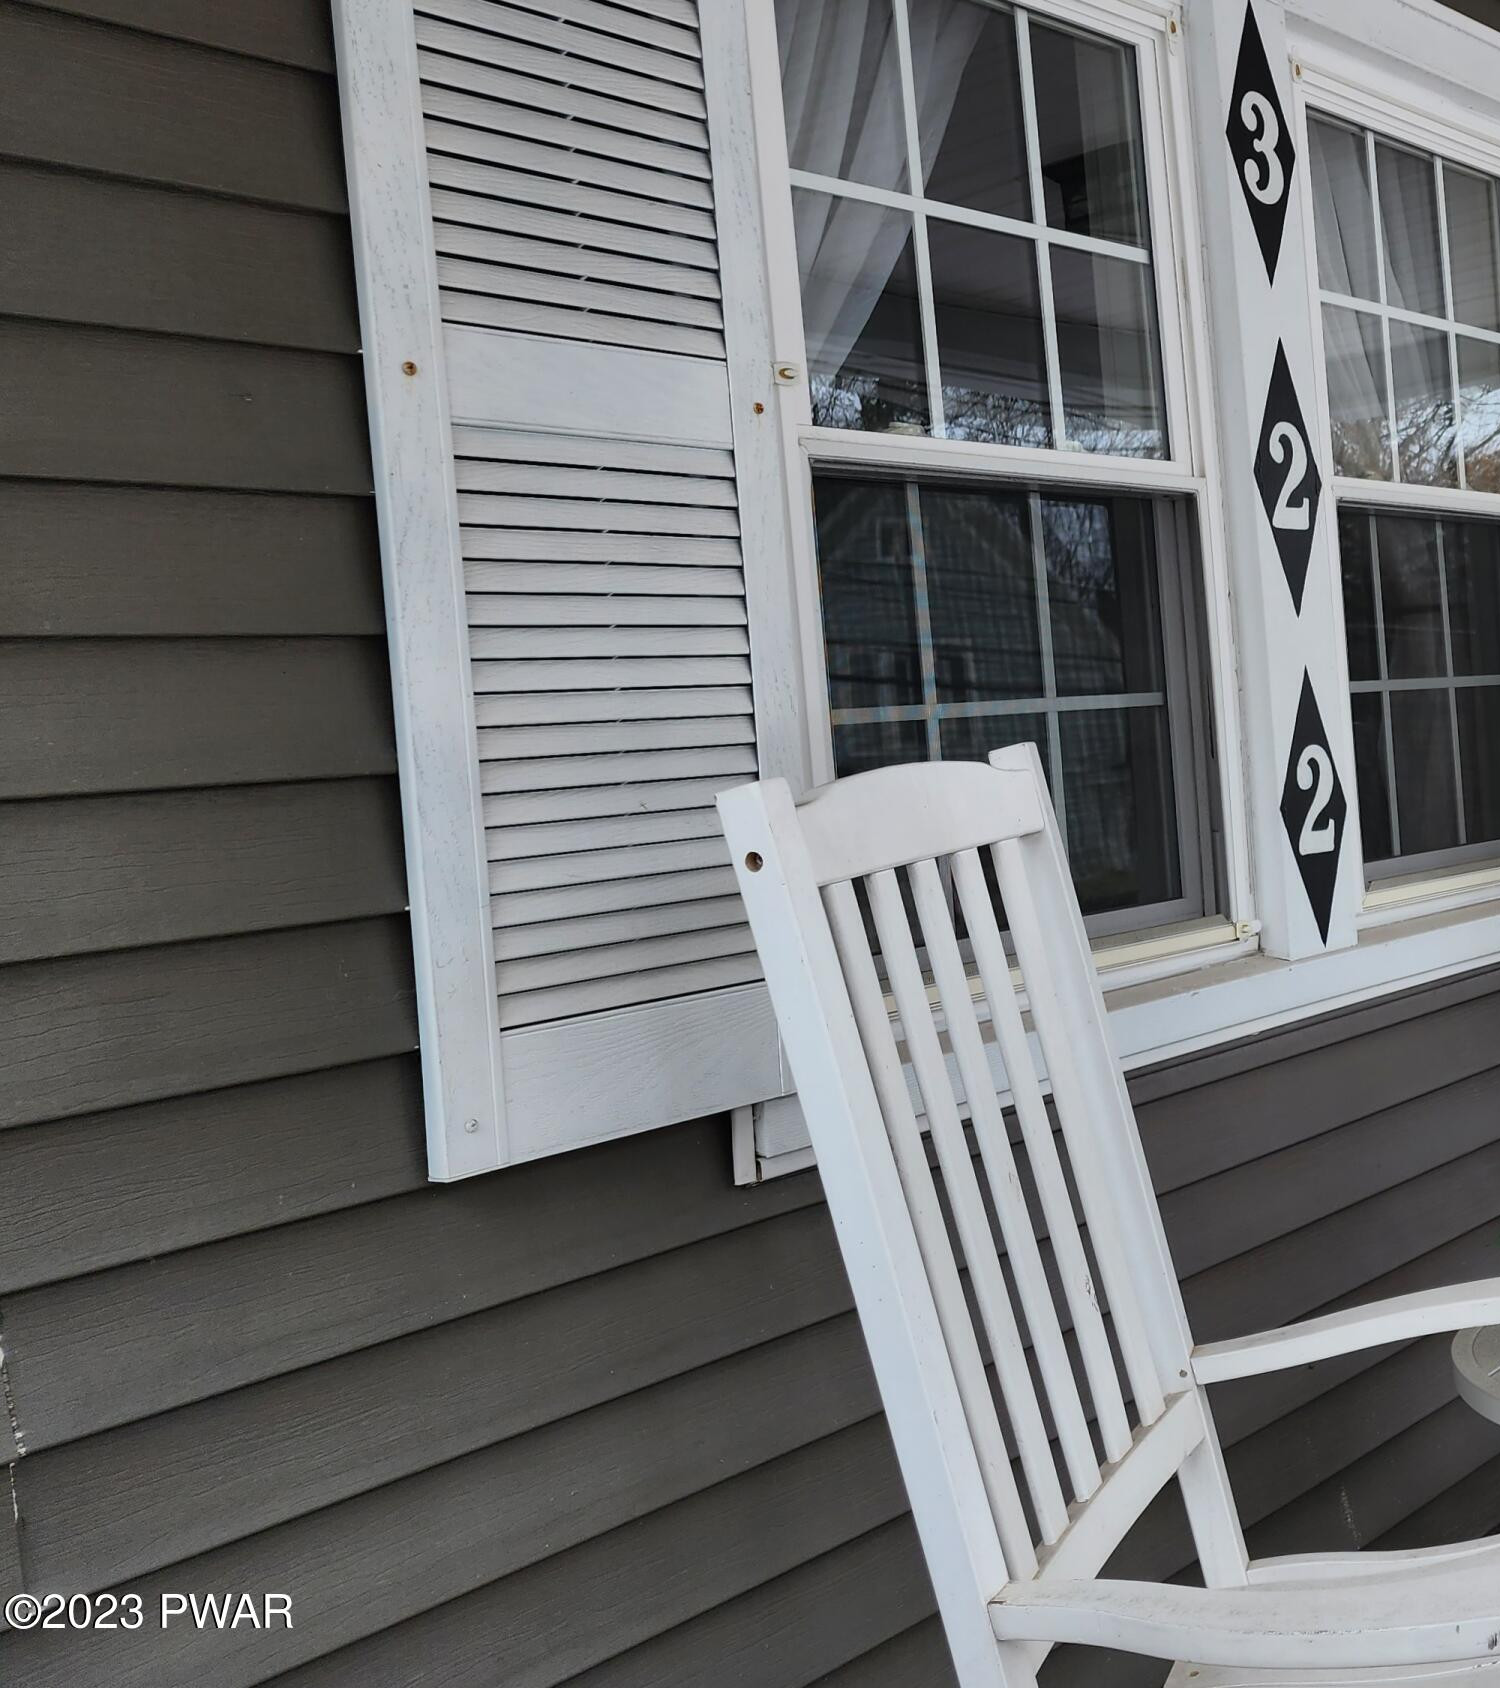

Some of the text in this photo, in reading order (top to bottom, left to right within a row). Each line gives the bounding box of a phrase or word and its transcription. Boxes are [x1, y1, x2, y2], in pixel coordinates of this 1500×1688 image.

[1240, 91, 1284, 205] 3
[1269, 421, 1309, 531] 2
[1296, 744, 1335, 856] 2
